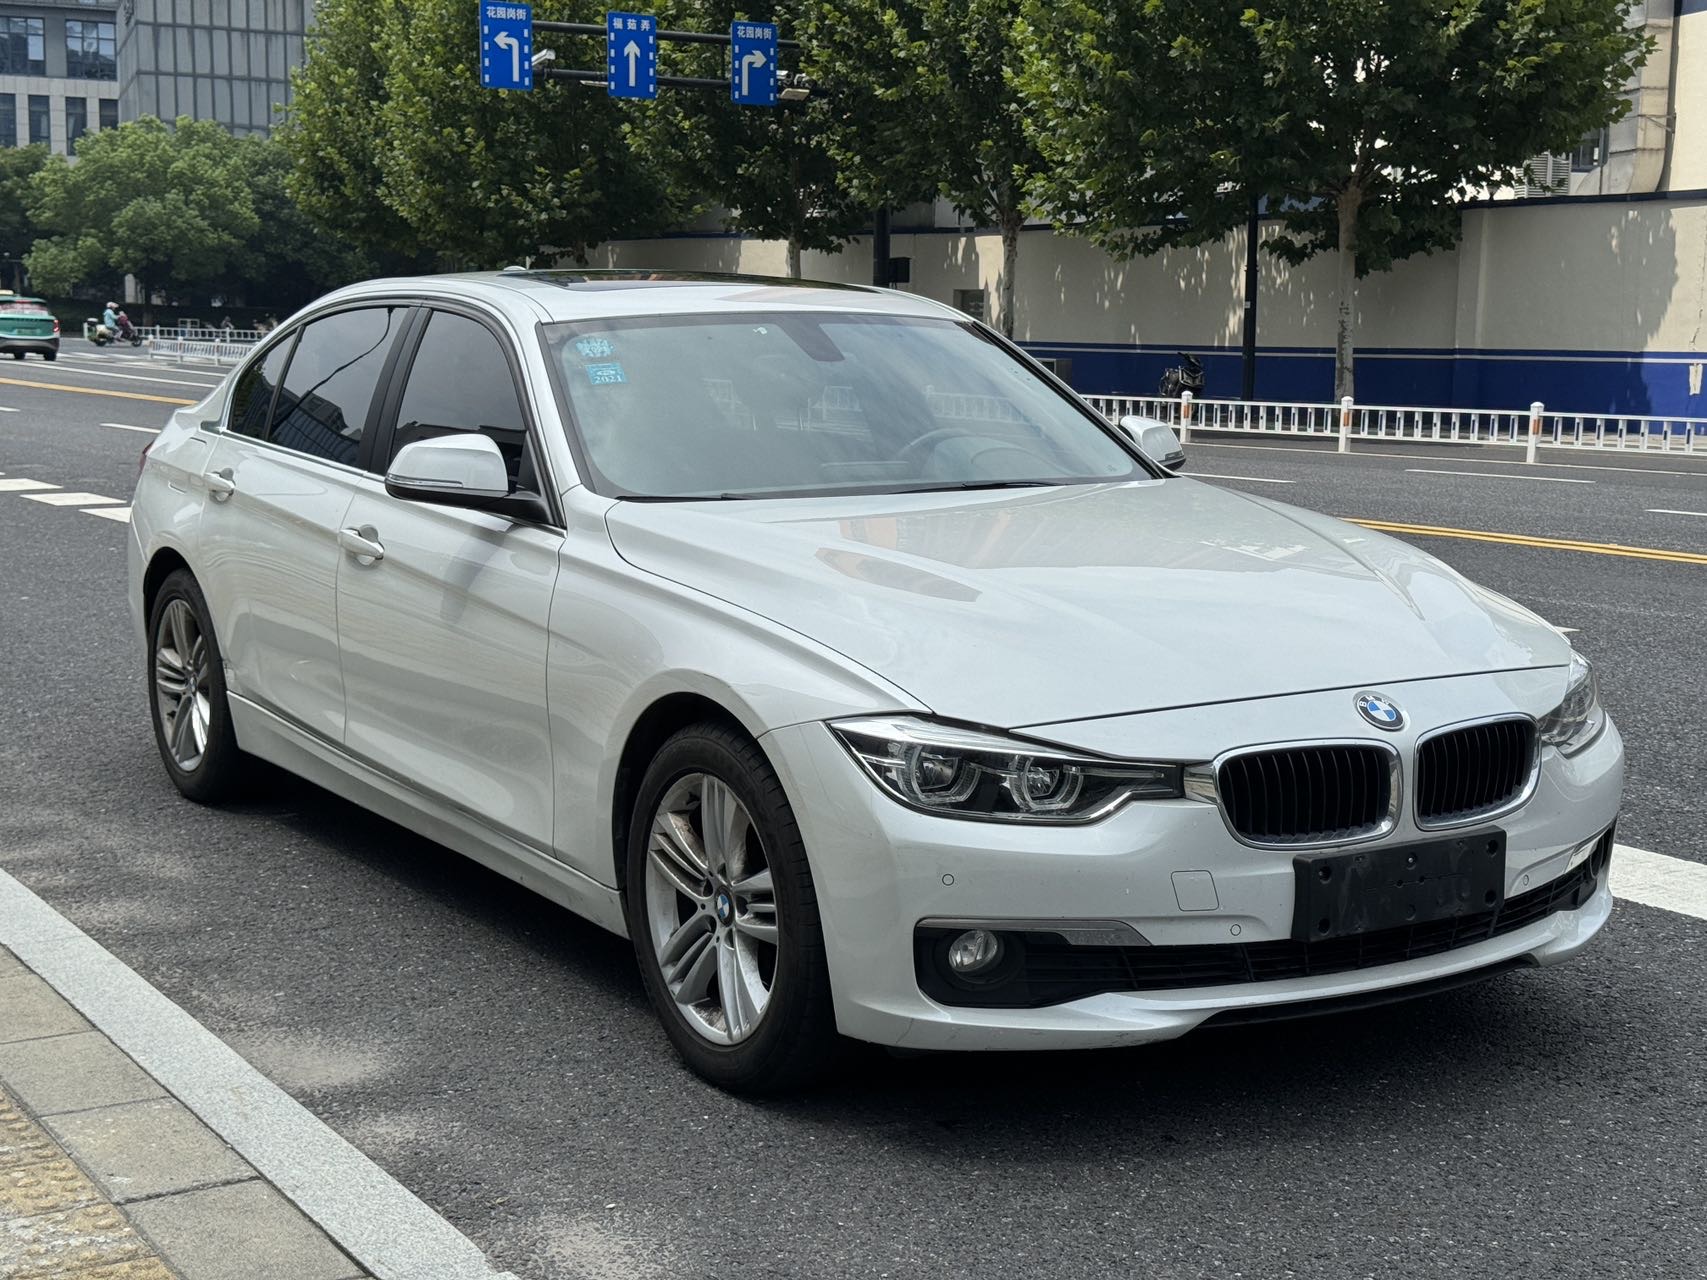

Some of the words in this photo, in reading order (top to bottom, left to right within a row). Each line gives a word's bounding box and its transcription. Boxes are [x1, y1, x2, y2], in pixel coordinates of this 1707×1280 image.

[486, 6, 527, 20] 花园岗街
[737, 26, 772, 40] 花园岗街
[592, 375, 622, 384] 2021
